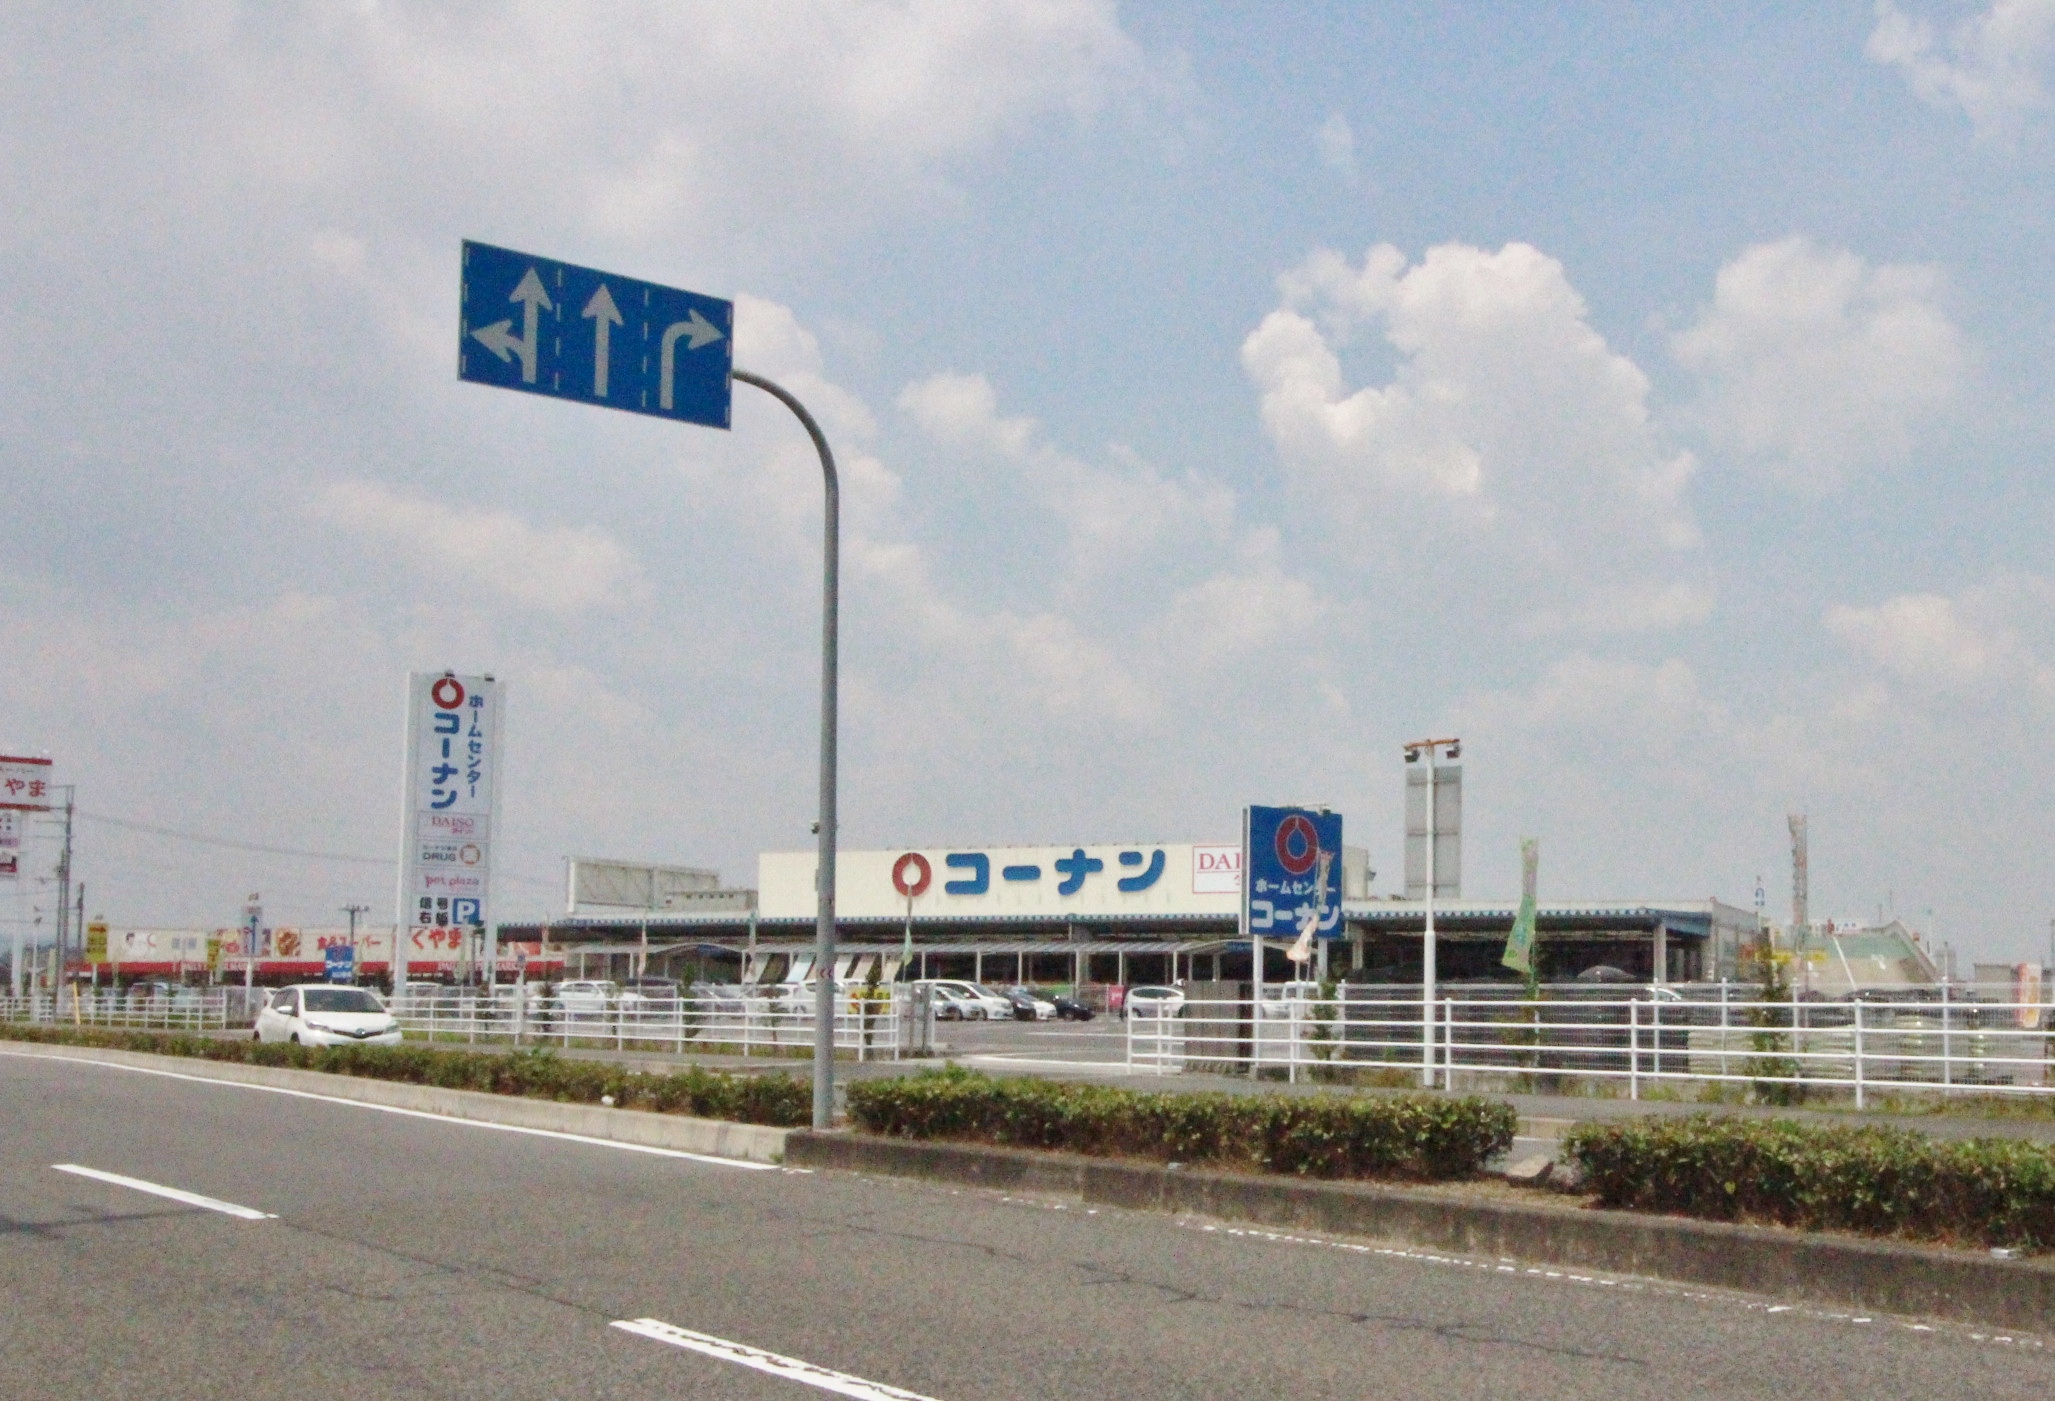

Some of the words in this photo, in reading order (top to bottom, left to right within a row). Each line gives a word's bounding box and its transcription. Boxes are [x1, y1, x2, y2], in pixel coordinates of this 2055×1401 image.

[430, 712, 460, 809] コーナン
[466, 695, 484, 799] ホームセンター
[944, 848, 1166, 896] コーナン
